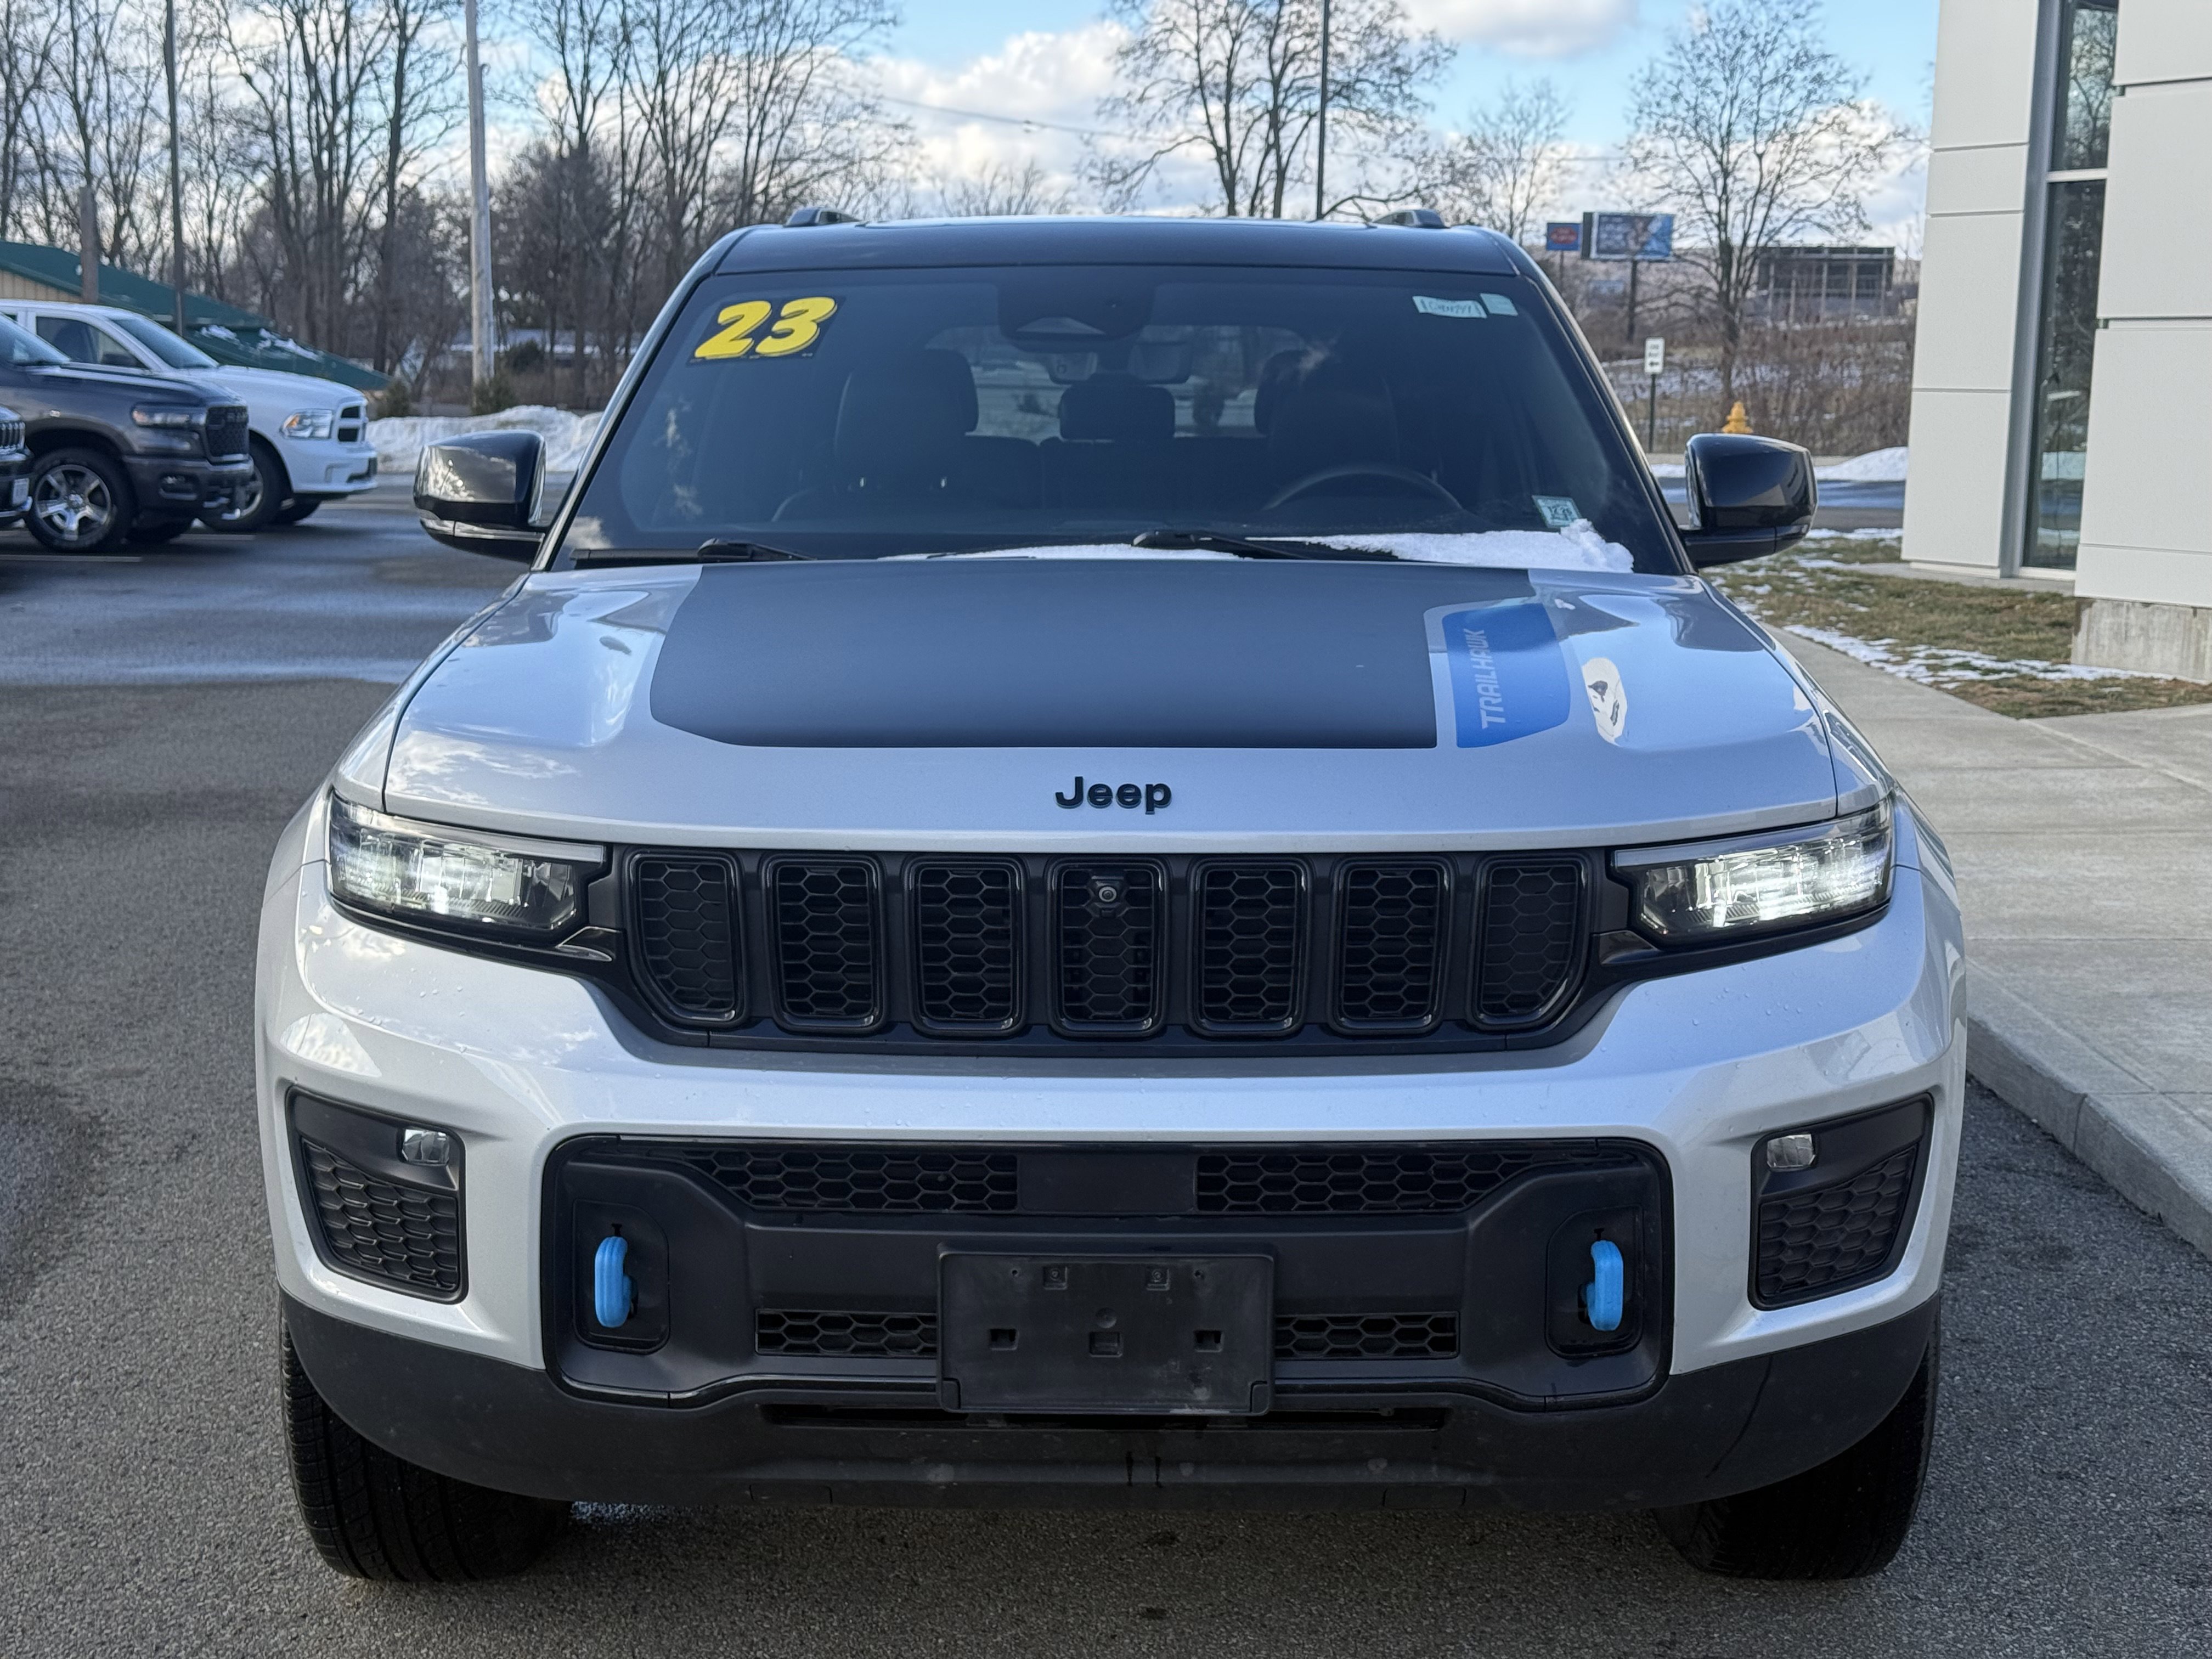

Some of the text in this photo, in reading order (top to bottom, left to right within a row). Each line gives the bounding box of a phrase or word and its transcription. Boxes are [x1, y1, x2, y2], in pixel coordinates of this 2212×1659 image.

[694, 296, 838, 359] 23
[1464, 628, 1506, 729] TRAILHAWK
[1055, 776, 1172, 815] Jeep
